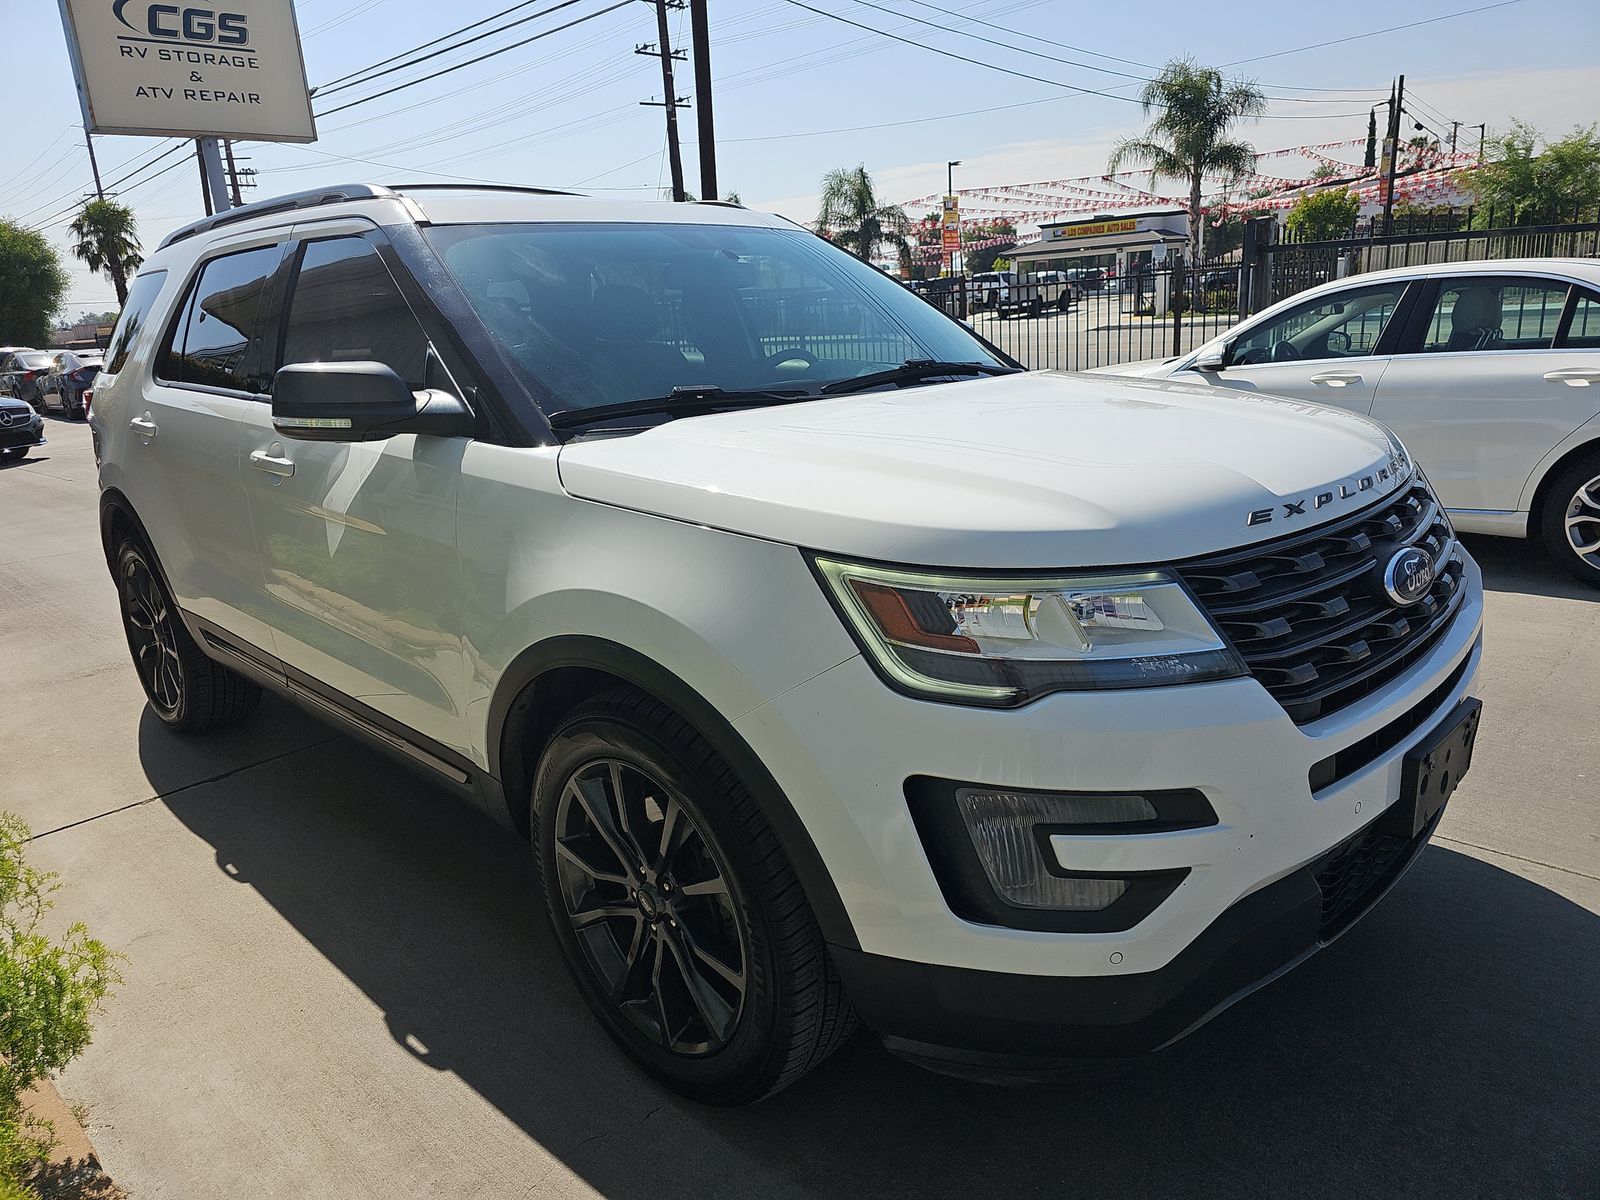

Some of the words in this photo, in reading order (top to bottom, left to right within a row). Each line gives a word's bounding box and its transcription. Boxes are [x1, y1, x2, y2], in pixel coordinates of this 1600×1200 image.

[147, 4, 249, 46] CGS
[120, 46, 147, 59] RV
[159, 49, 260, 69] STORAGE
[190, 71, 204, 82] &
[135, 86, 174, 99] ATV
[185, 89, 261, 104] REPAIR
[1107, 222, 1120, 233] AUTO
[1120, 221, 1136, 232] SALES
[1247, 452, 1406, 526] EXPLORER
[1404, 555, 1434, 591] Ford
